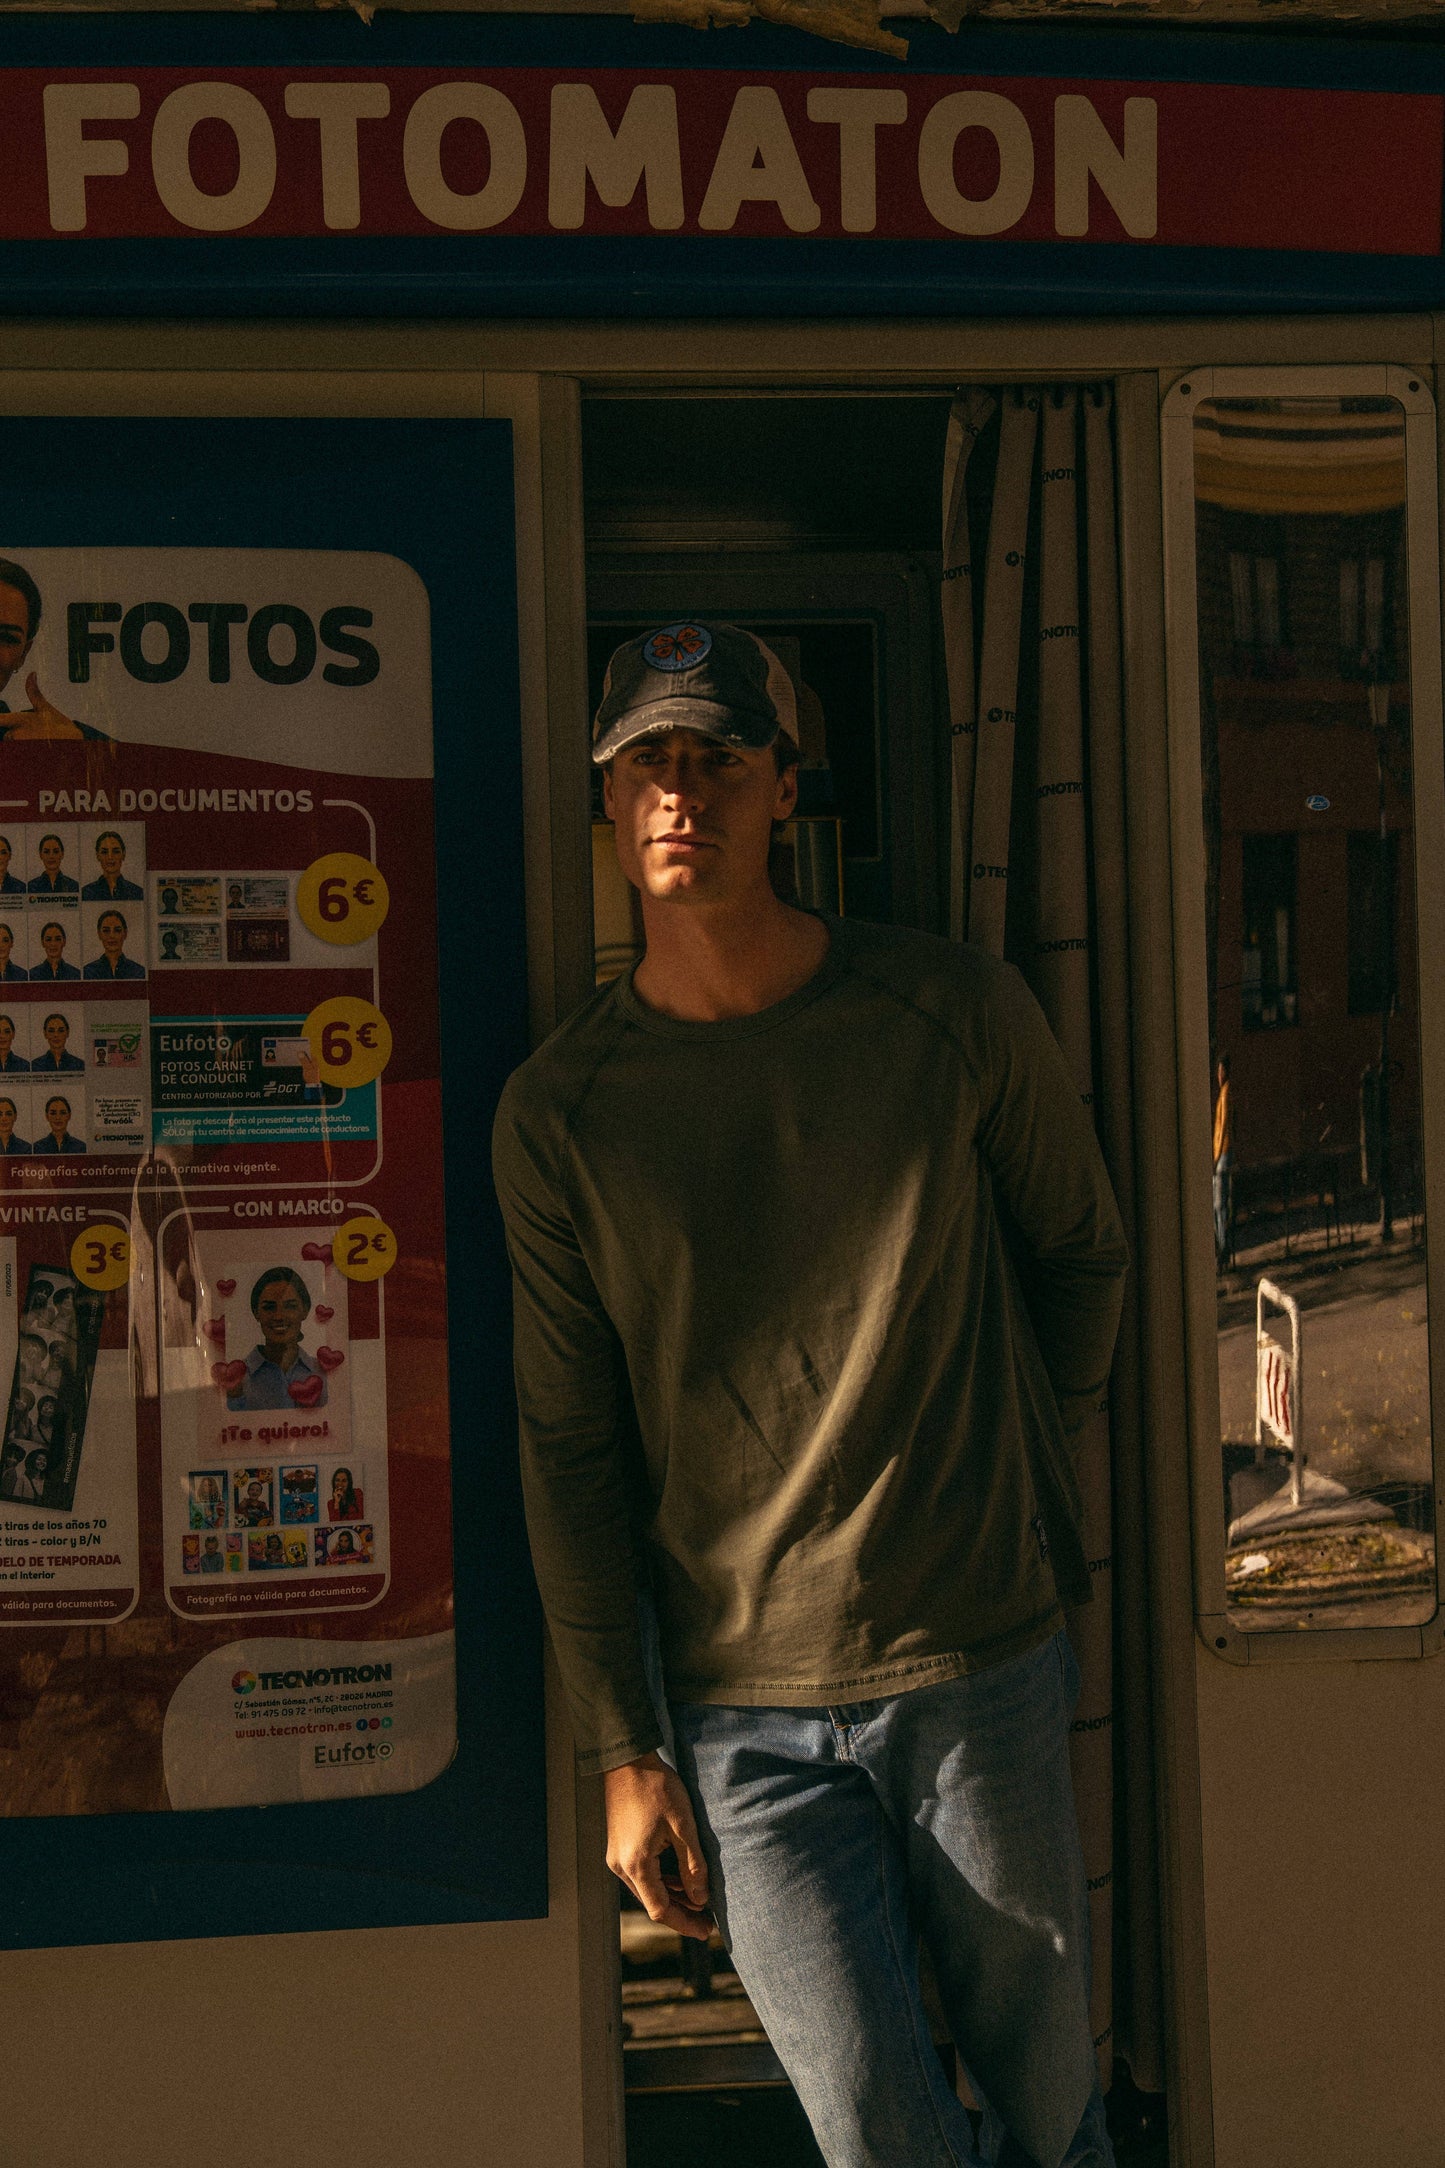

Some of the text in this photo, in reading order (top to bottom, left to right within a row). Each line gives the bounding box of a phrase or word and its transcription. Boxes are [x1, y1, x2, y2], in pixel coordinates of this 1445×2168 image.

[43, 80, 1159, 239] FOTOMATON
[66, 601, 381, 687] FOTOS
[38, 788, 314, 814] PARA DOCUMENTOS
[317, 877, 375, 923] 6€
[321, 1021, 379, 1066] 6€
[160, 1059, 254, 1073] FOTOS CARNET
[160, 1072, 248, 1085] DE CONDUCIR
[161, 1091, 261, 1100] CENTRO AUTORIZADO POR
[277, 1083, 302, 1094] DGT
[173, 1117, 191, 1126] foto
[256, 1115, 295, 1127] presentar
[296, 1114, 314, 1123] este
[236, 1126, 247, 1135] de
[309, 1124, 321, 1133] de
[11, 1162, 281, 1180] Fotografías conformes a la normativa vigente.
[0, 1205, 87, 1223] VINTAGE
[233, 1198, 346, 1218] CON MARCO
[85, 1241, 127, 1274] 3€
[346, 1232, 388, 1266] 2€
[221, 1420, 329, 1444] ¡Te quiero!
[5, 1521, 30, 1531] tiras
[32, 1521, 45, 1530] de
[47, 1520, 63, 1530] los
[65, 1519, 91, 1529] años
[92, 1519, 107, 1529] 70
[5, 1537, 30, 1546] tiras
[40, 1536, 68, 1546] color
[70, 1538, 77, 1548] y
[79, 1533, 101, 1546] B/N
[29, 1556, 45, 1567] DE
[47, 1554, 122, 1566] TEMPORADA
[186, 1584, 370, 1606] Fotografía no válida para documentos.
[2, 1598, 118, 1612] válida para documentos.
[258, 1663, 392, 1691] TECNOTRON
[365, 1690, 394, 1700] MADRID
[235, 1721, 352, 1739] www.tecnotron.es
